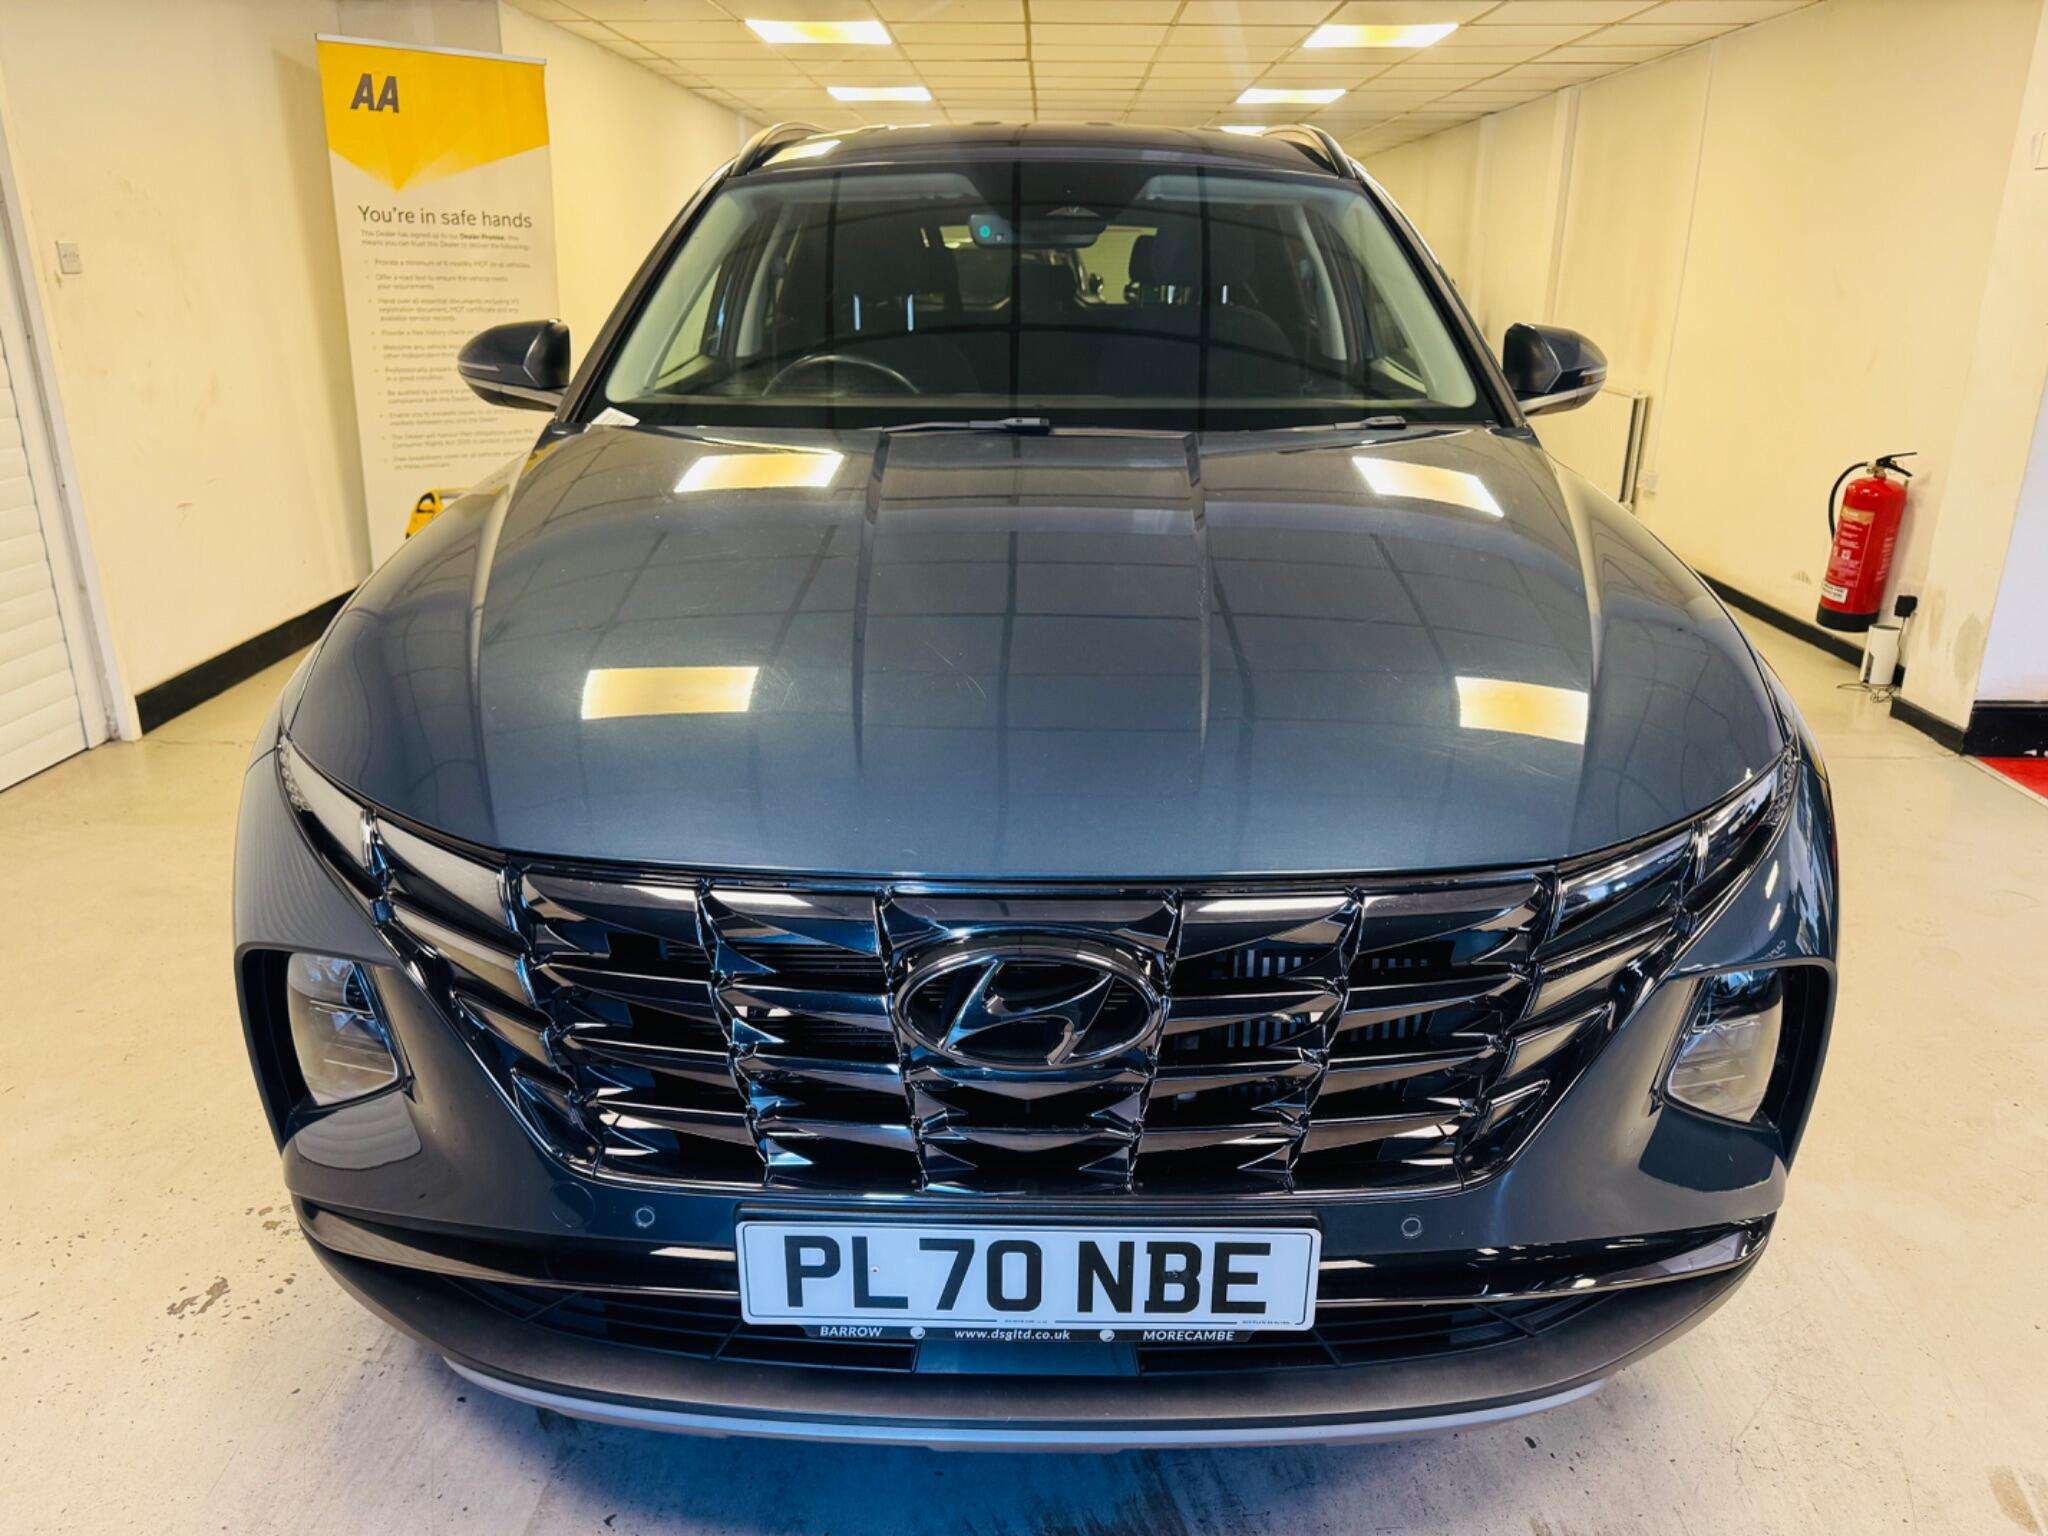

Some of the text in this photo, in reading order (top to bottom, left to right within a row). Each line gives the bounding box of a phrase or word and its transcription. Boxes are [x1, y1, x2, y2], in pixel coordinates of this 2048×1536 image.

[351, 73, 399, 113] AA
[358, 205, 533, 228] You're in safe hands
[784, 1235, 1271, 1314] PL70 NBE
[820, 1326, 882, 1337] BARROW
[954, 1328, 1070, 1341] www.dsgltd.co.uk
[1143, 1331, 1236, 1341] MORECAMBE
